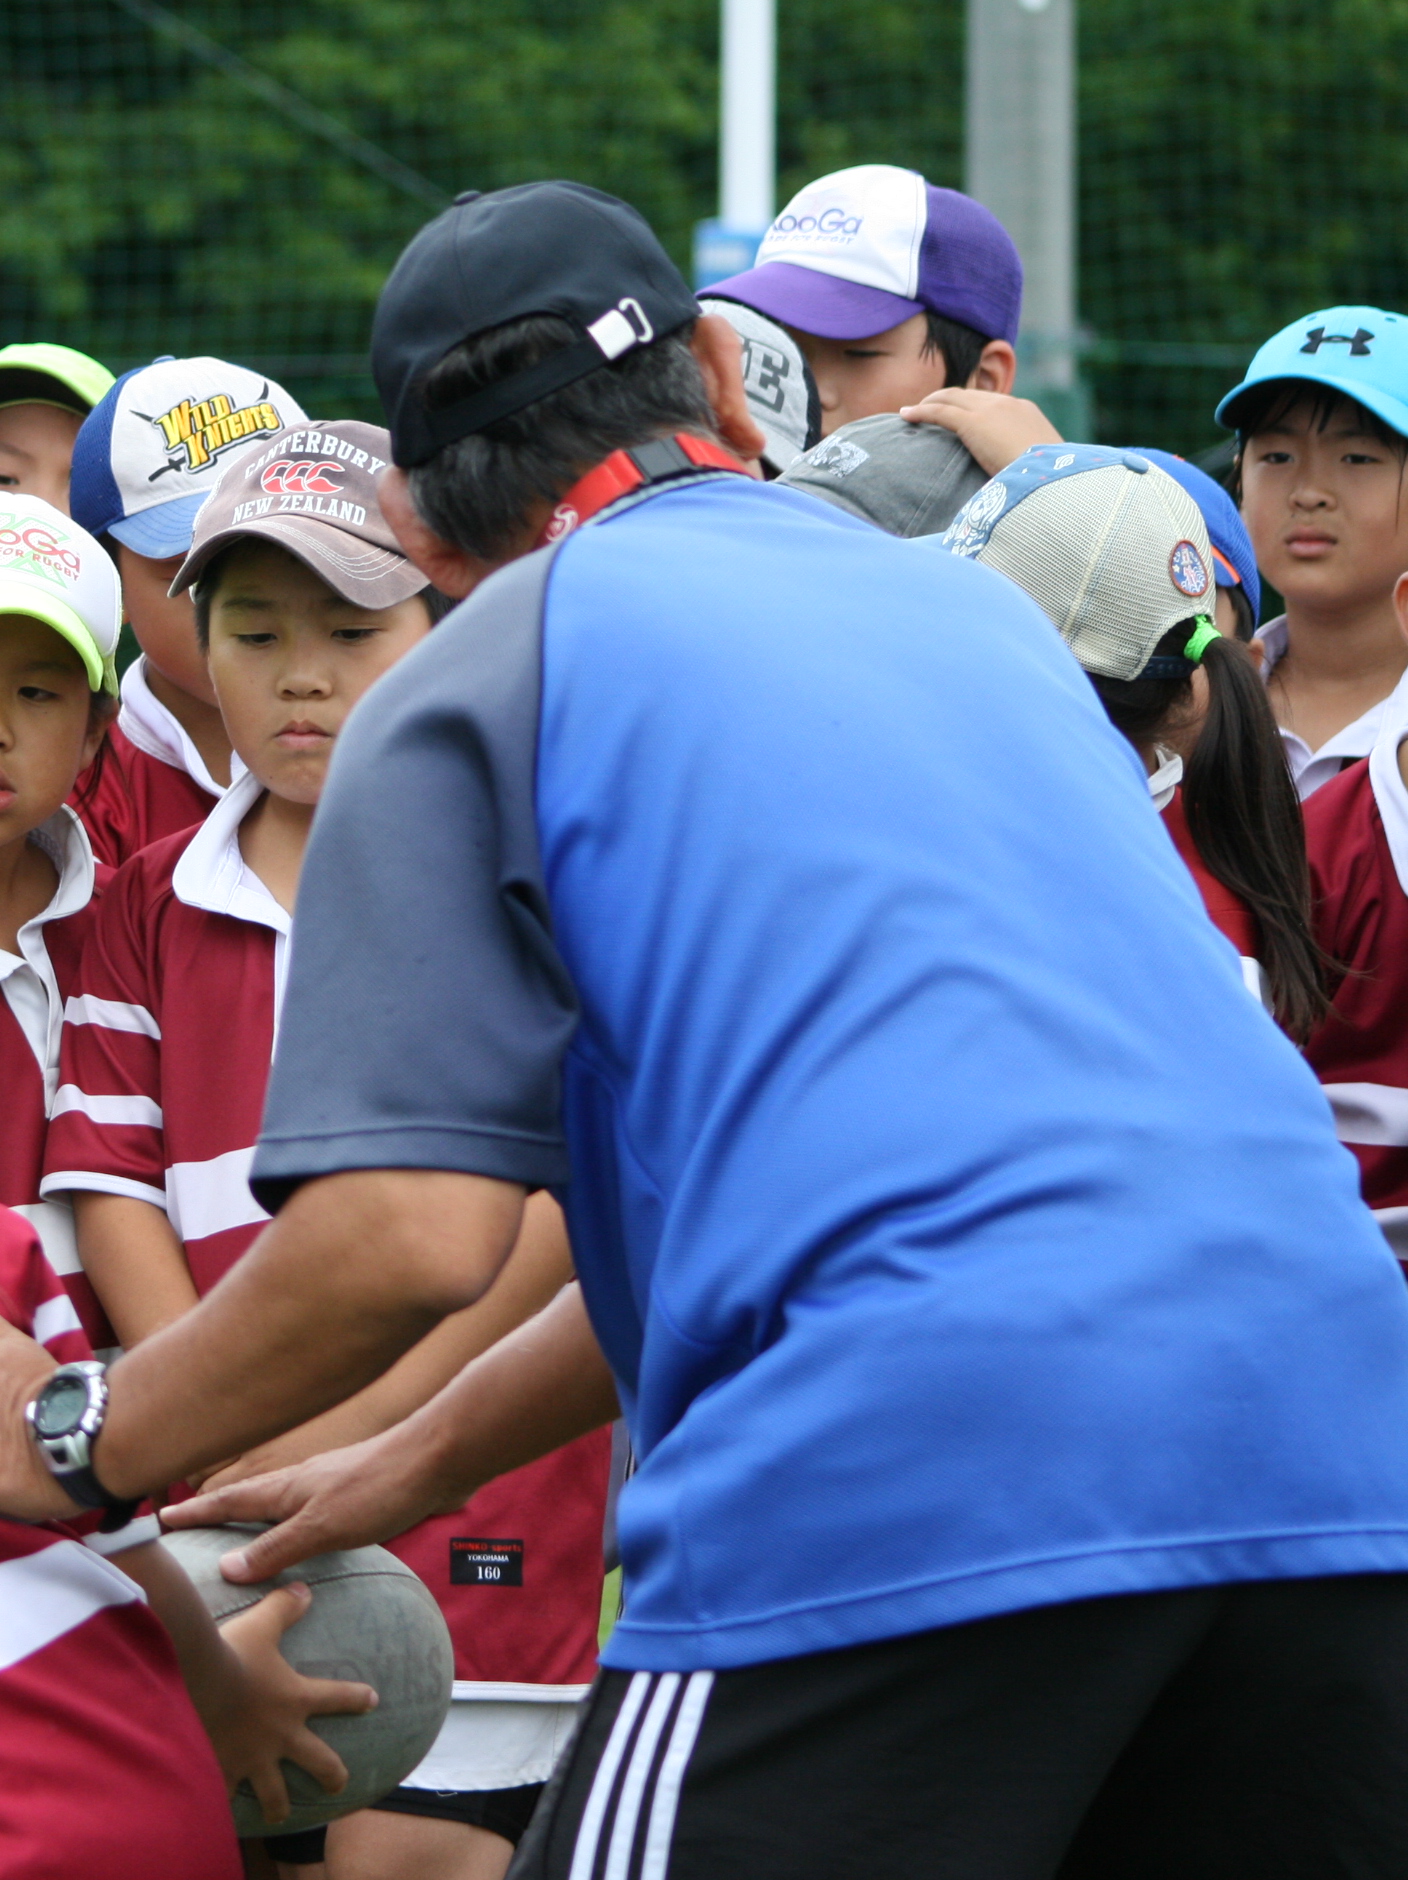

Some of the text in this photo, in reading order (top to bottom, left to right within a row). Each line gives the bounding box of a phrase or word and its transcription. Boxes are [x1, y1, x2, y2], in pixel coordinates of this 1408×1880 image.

[773, 207, 863, 235] ooGa
[184, 403, 280, 469] KNIGHTS
[244, 430, 387, 480] CANTERBURY
[232, 495, 367, 528] NEW ZEALAND
[32, 553, 80, 582] RUGBY
[467, 1553, 510, 1563] YOKOHAMA
[477, 1565, 502, 1580] 160
